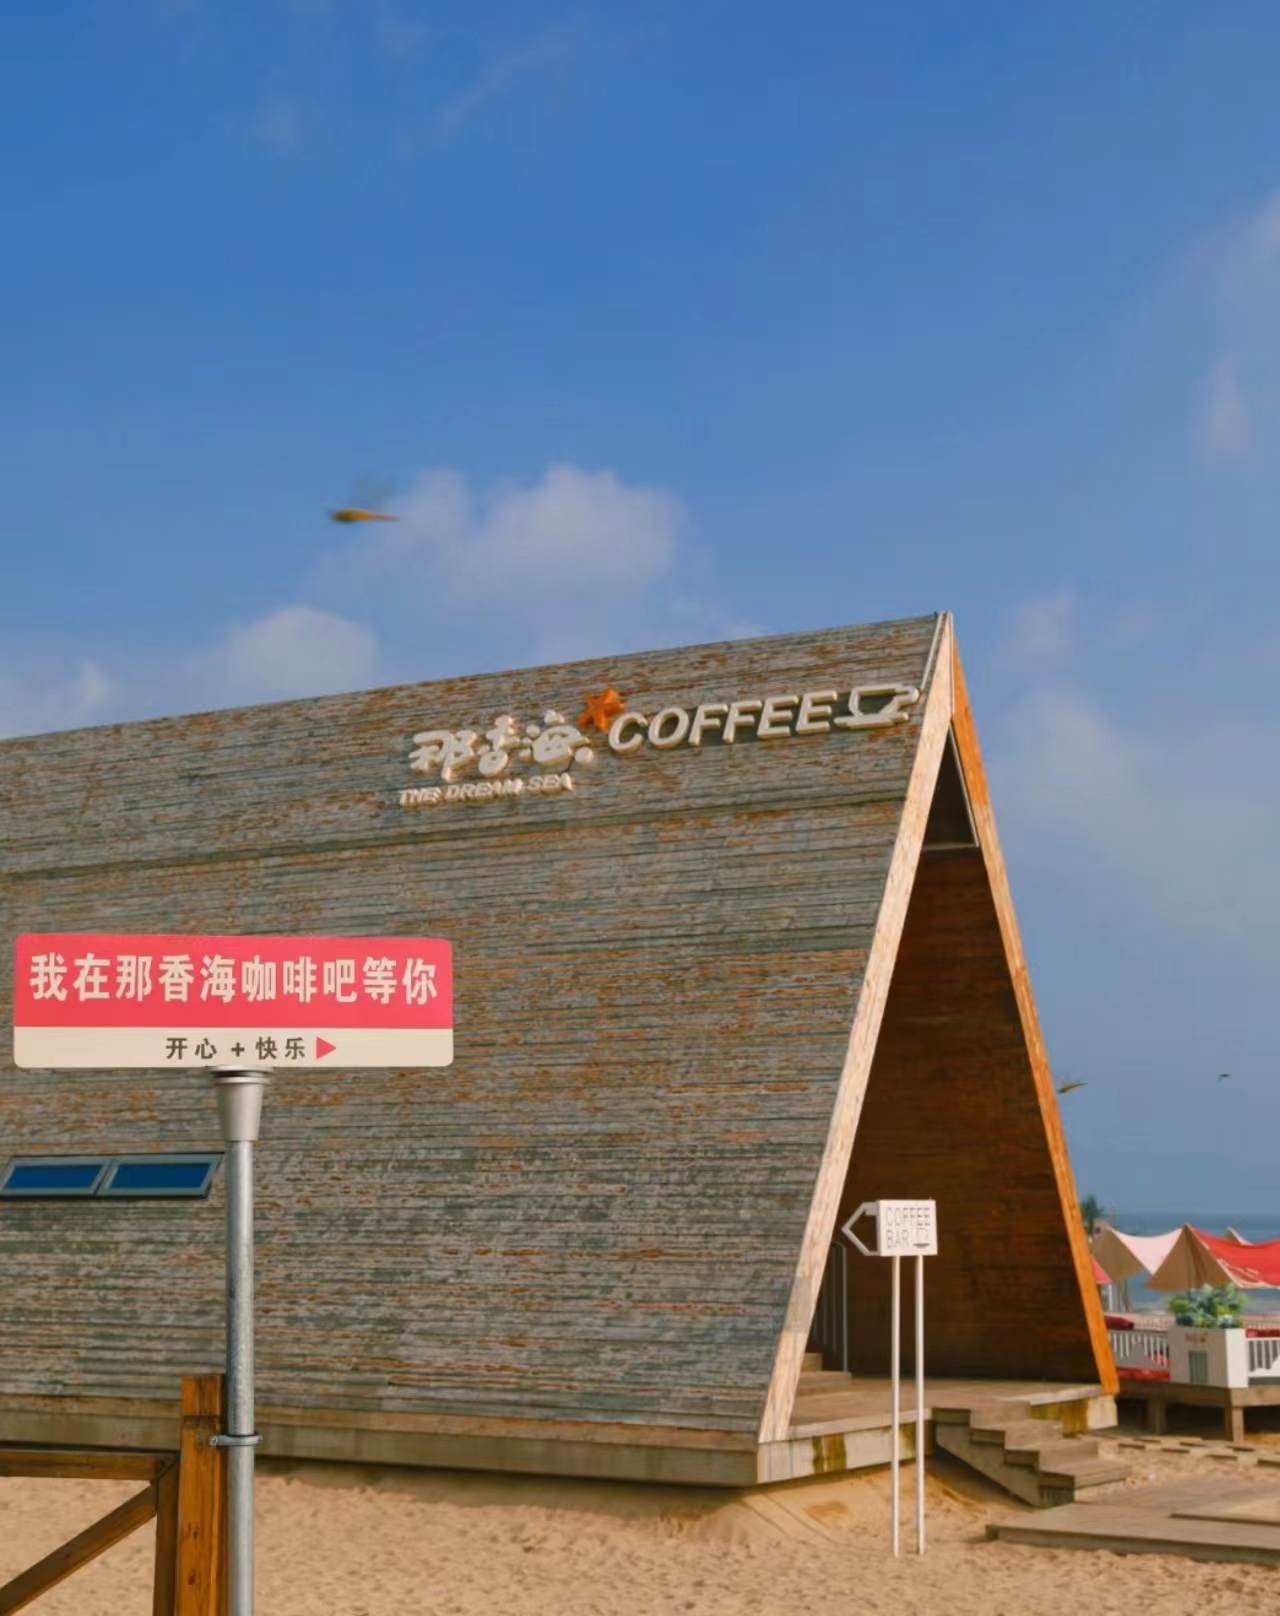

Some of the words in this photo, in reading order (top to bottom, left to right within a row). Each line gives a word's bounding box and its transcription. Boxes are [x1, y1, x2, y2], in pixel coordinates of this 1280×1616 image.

[608, 690, 838, 752] COFFEE
[444, 778, 523, 800] DREAM
[528, 772, 574, 793] SEA
[29, 951, 439, 1006] 我在那香海咖啡吧等你
[886, 1206, 931, 1227] COFFEE
[886, 1228, 910, 1249] BAR
